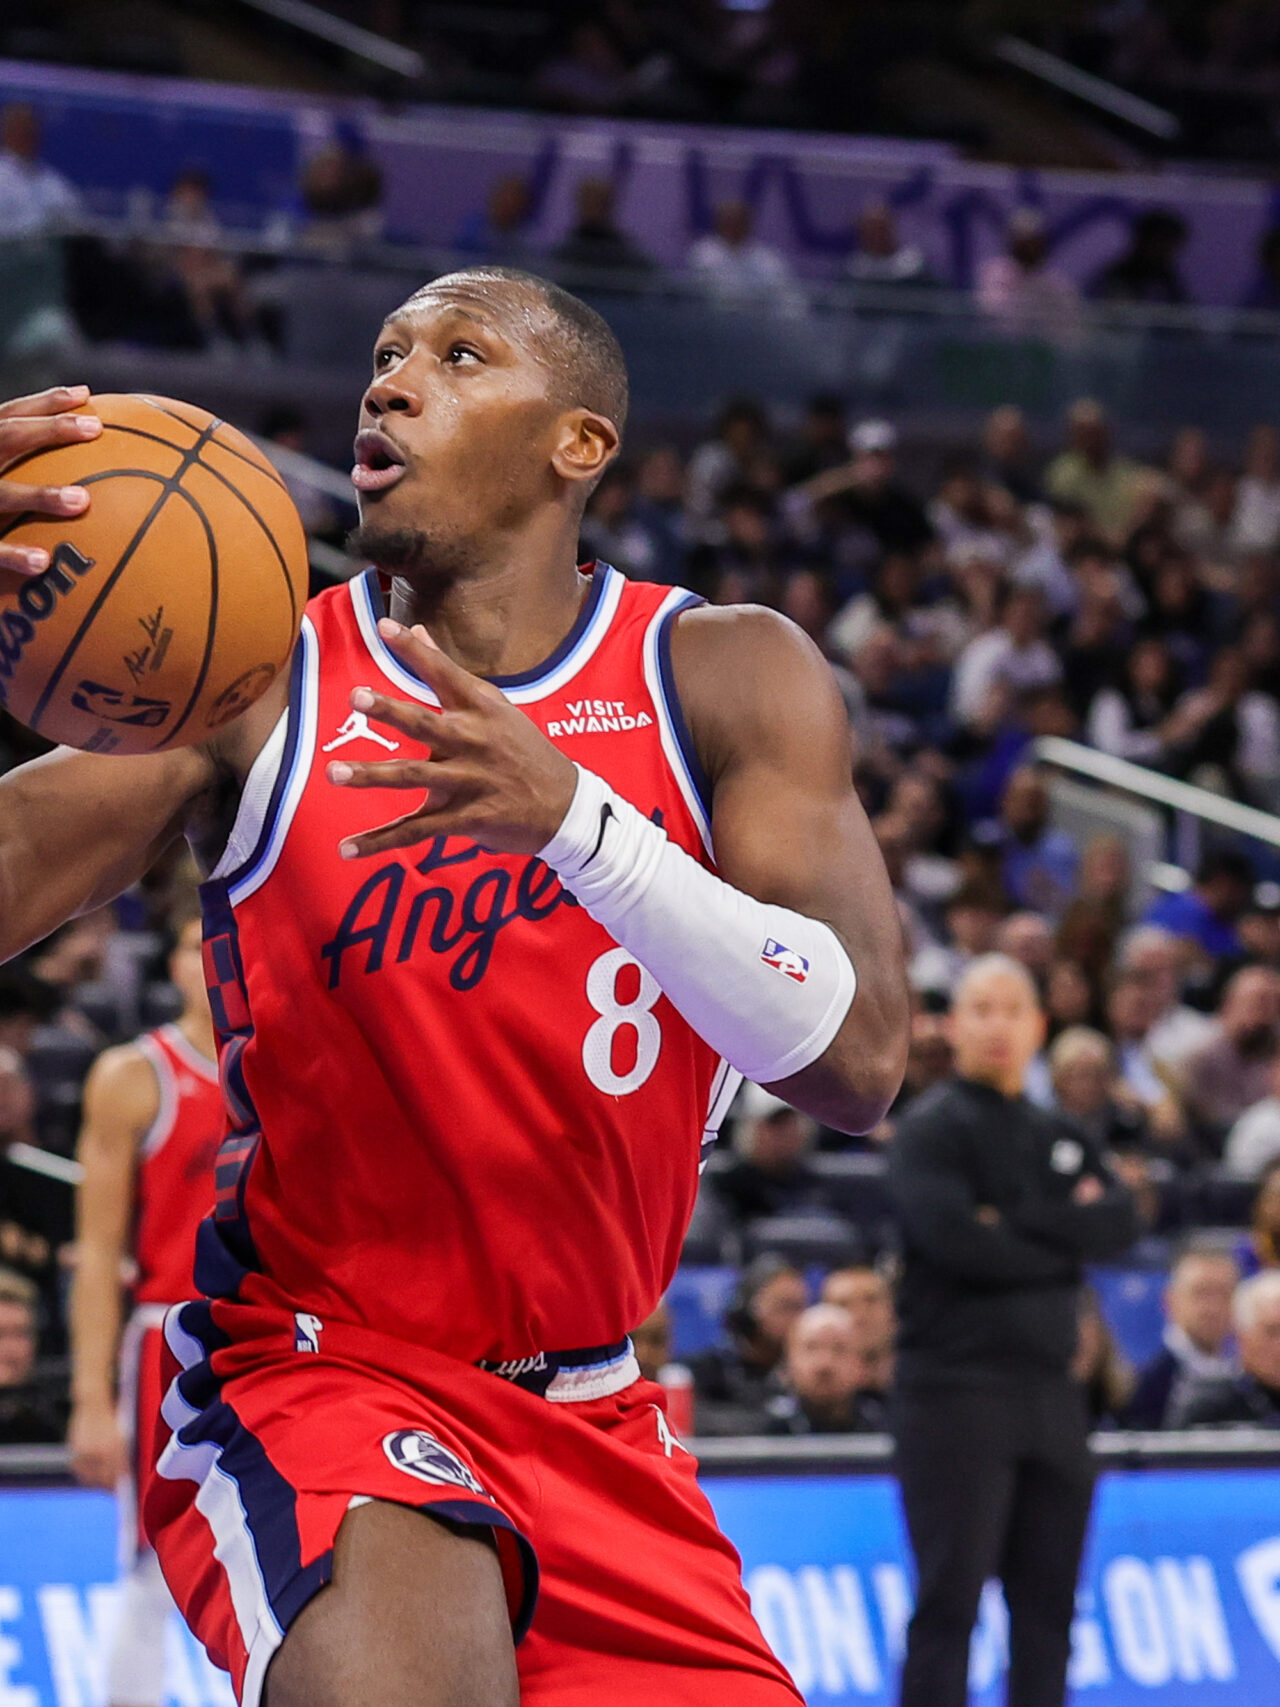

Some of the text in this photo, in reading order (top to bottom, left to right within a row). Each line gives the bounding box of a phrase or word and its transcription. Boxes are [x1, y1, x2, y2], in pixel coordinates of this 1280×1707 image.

[546, 711, 653, 738] RWANDA
[565, 699, 625, 717] VISIT
[321, 856, 579, 991] Ange
[582, 946, 663, 1097] 8
